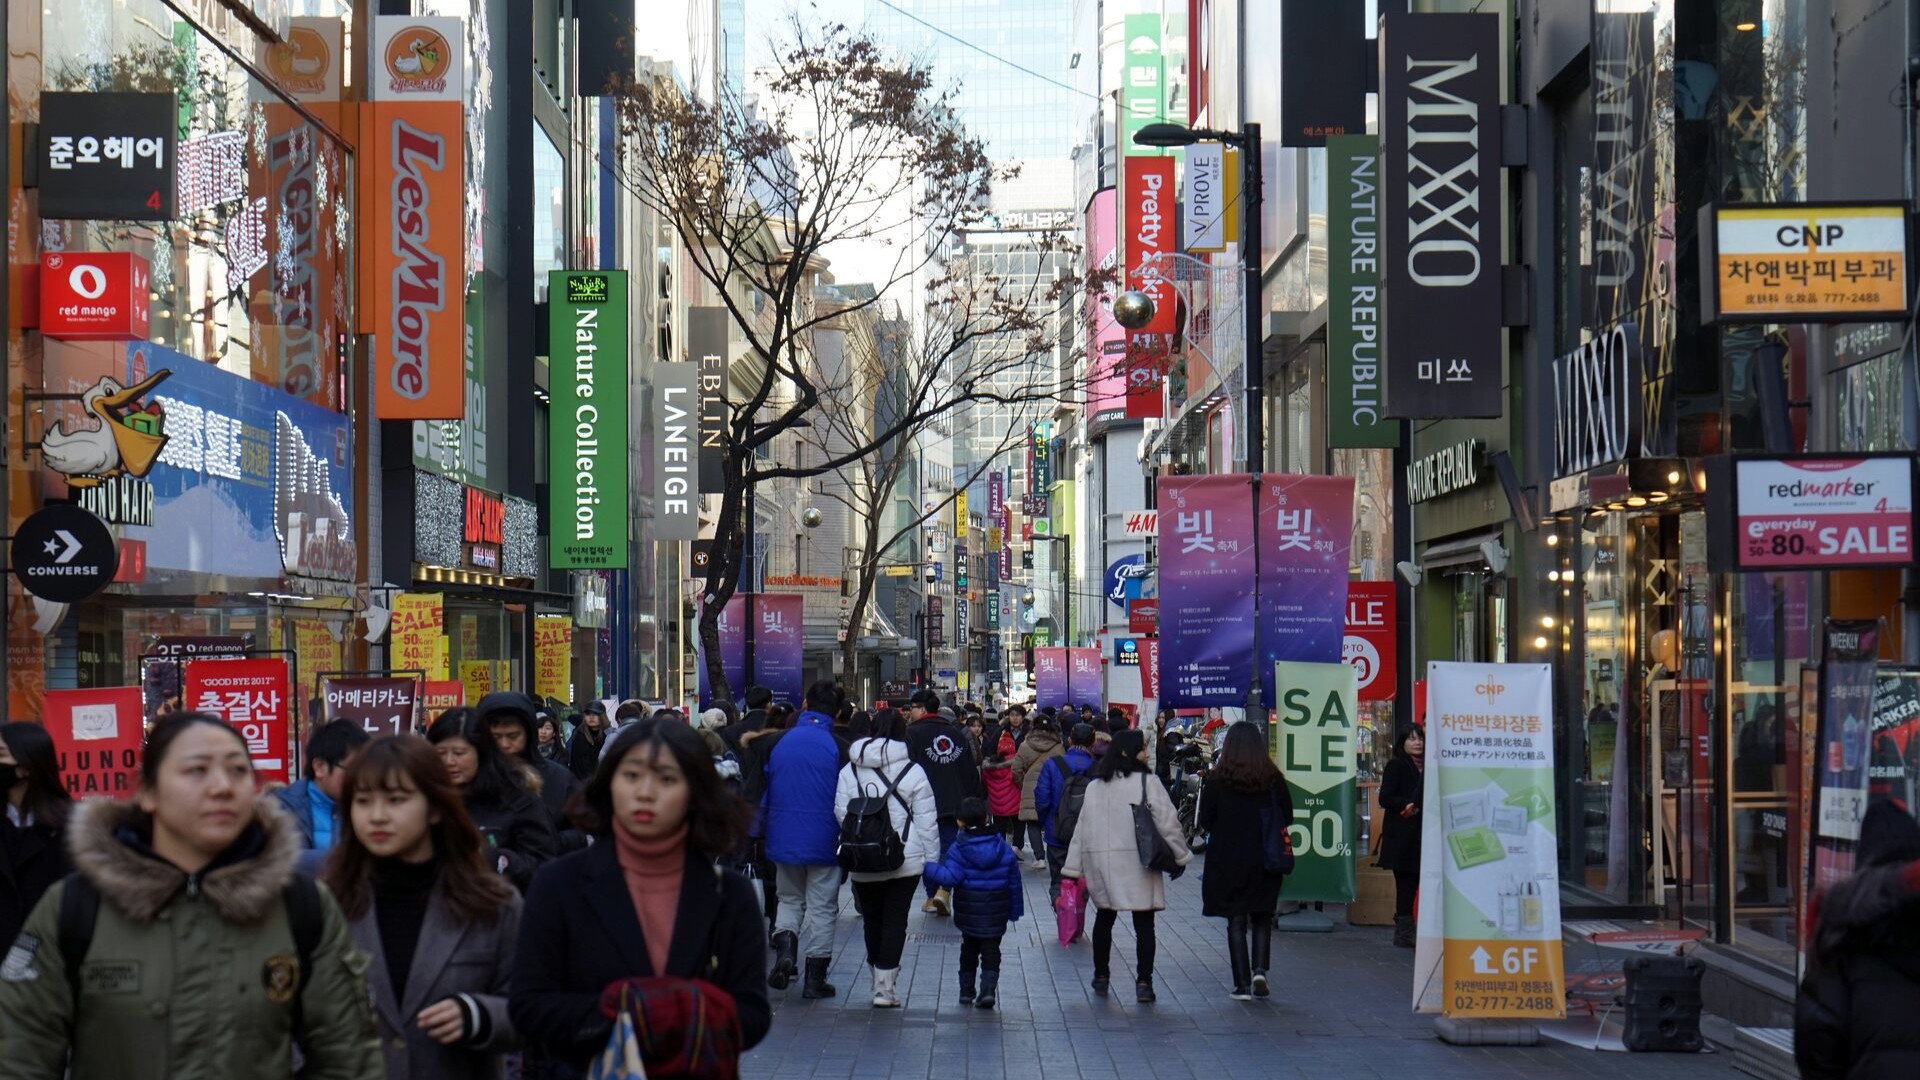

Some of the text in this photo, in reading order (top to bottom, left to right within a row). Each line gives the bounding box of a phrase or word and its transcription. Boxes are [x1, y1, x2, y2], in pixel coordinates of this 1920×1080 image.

[49, 136, 164, 170] 준오헤어
[1406, 53, 1481, 287] MIXXO
[146, 190, 161, 210] 4
[1138, 174, 1162, 248] Pretty
[1776, 224, 1844, 247] CNP
[392, 120, 444, 399] LesMore
[1727, 258, 1896, 287] 차앤박피부과
[1350, 156, 1377, 426] NATURE REPUBLIC
[1823, 292, 1880, 303] 777-2488
[58, 304, 117, 318] red mango
[1417, 358, 1473, 384] 미쏘
[702, 353, 721, 448] EBLIN
[576, 308, 600, 541] Nature Collection
[663, 387, 688, 515] LANEIGE
[1406, 438, 1478, 505] NATURE REPUBLIC
[1768, 476, 1875, 498] redmarker
[121, 477, 154, 527] HAIR
[1126, 514, 1157, 533] H&M
[1177, 509, 1238, 554] 빛 축제
[1277, 508, 1334, 552] 빛 축제
[1748, 518, 1817, 538] everyday
[1818, 525, 1908, 555] SALE
[27, 565, 99, 576] CONVERSE
[391, 607, 444, 635] SALE
[762, 610, 783, 633] 빛
[1344, 601, 1385, 626] LE
[1351, 644, 1364, 652] TO
[233, 677, 250, 685] BYE
[1475, 684, 1505, 695] CNP
[196, 690, 281, 721] 총결산
[328, 689, 411, 708] 아메리카노
[1282, 688, 1351, 729] SA
[1440, 713, 1543, 733] 차앤박화장품
[60, 749, 135, 771] JUNO
[1286, 733, 1348, 773] LE
[66, 772, 128, 792] HAIR
[1305, 797, 1325, 807] up to
[1286, 808, 1352, 858] 50%
[1502, 947, 1538, 974] 6F
[1454, 980, 1554, 994] 차앤박피부과 명동점
[1455, 996, 1555, 1011] 02-777-2488
